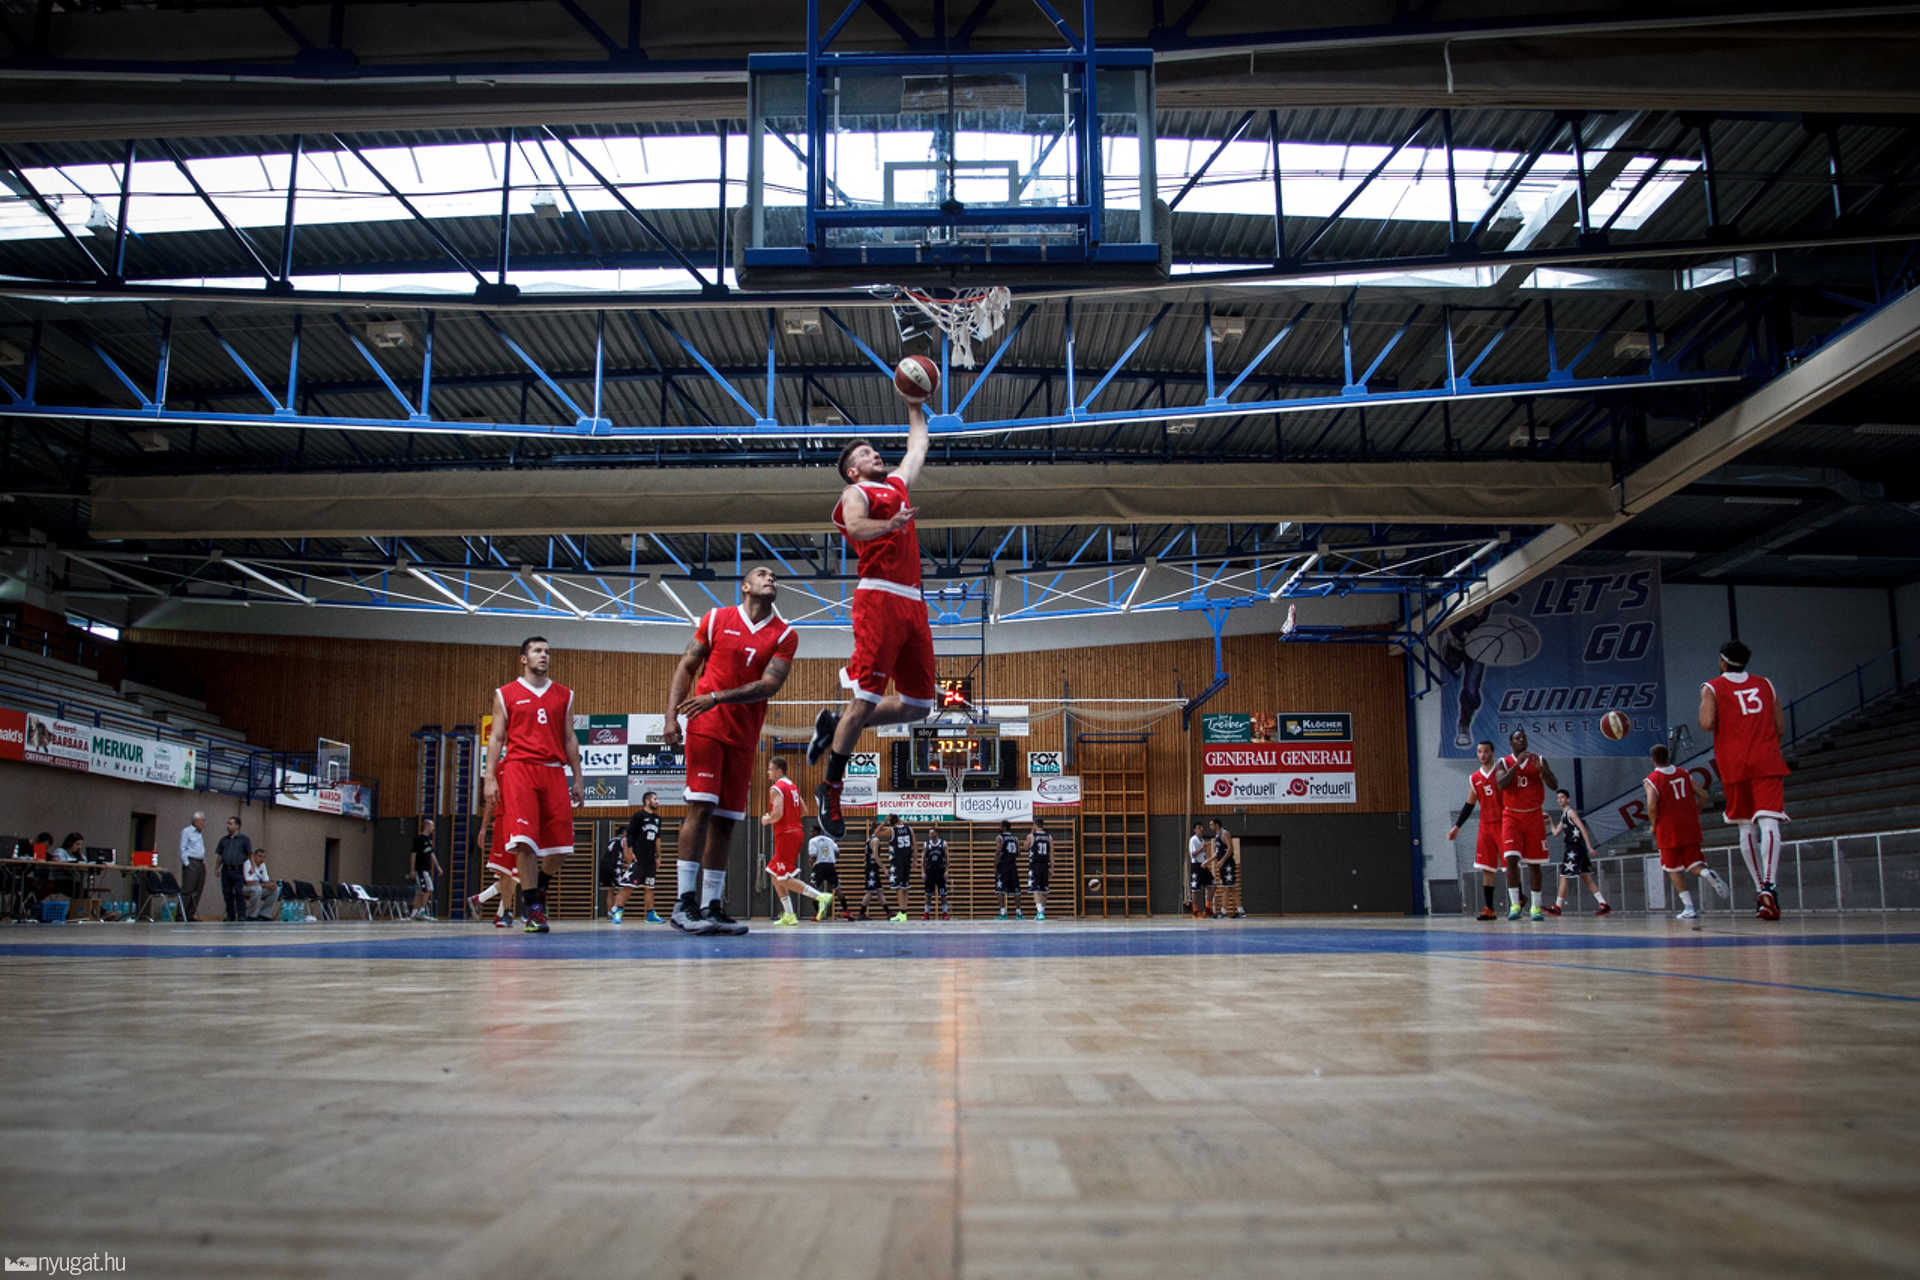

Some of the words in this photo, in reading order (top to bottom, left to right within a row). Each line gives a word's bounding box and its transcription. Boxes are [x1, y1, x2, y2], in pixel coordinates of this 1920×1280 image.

[1531, 571, 1651, 617] LET'S
[1583, 621, 1656, 664] GO
[744, 647, 757, 667] 7
[1500, 683, 1659, 713] GUNNERS
[1733, 687, 1763, 715] 13
[537, 708, 548, 724] 8
[1499, 717, 1660, 735] BASKETLL
[51, 734, 89, 752] BARBARA
[92, 736, 144, 763] MERKUR
[579, 750, 622, 766] lser
[848, 754, 876, 766] FOX
[1031, 753, 1058, 765] FOX
[1205, 751, 1277, 766] GENERALI
[1280, 750, 1352, 765] GENERALI
[1234, 782, 1276, 795] redwell
[1310, 781, 1350, 795] redwell
[1517, 775, 1528, 787] 10
[1670, 777, 1686, 800] 17
[960, 797, 1022, 813] ideas4you
